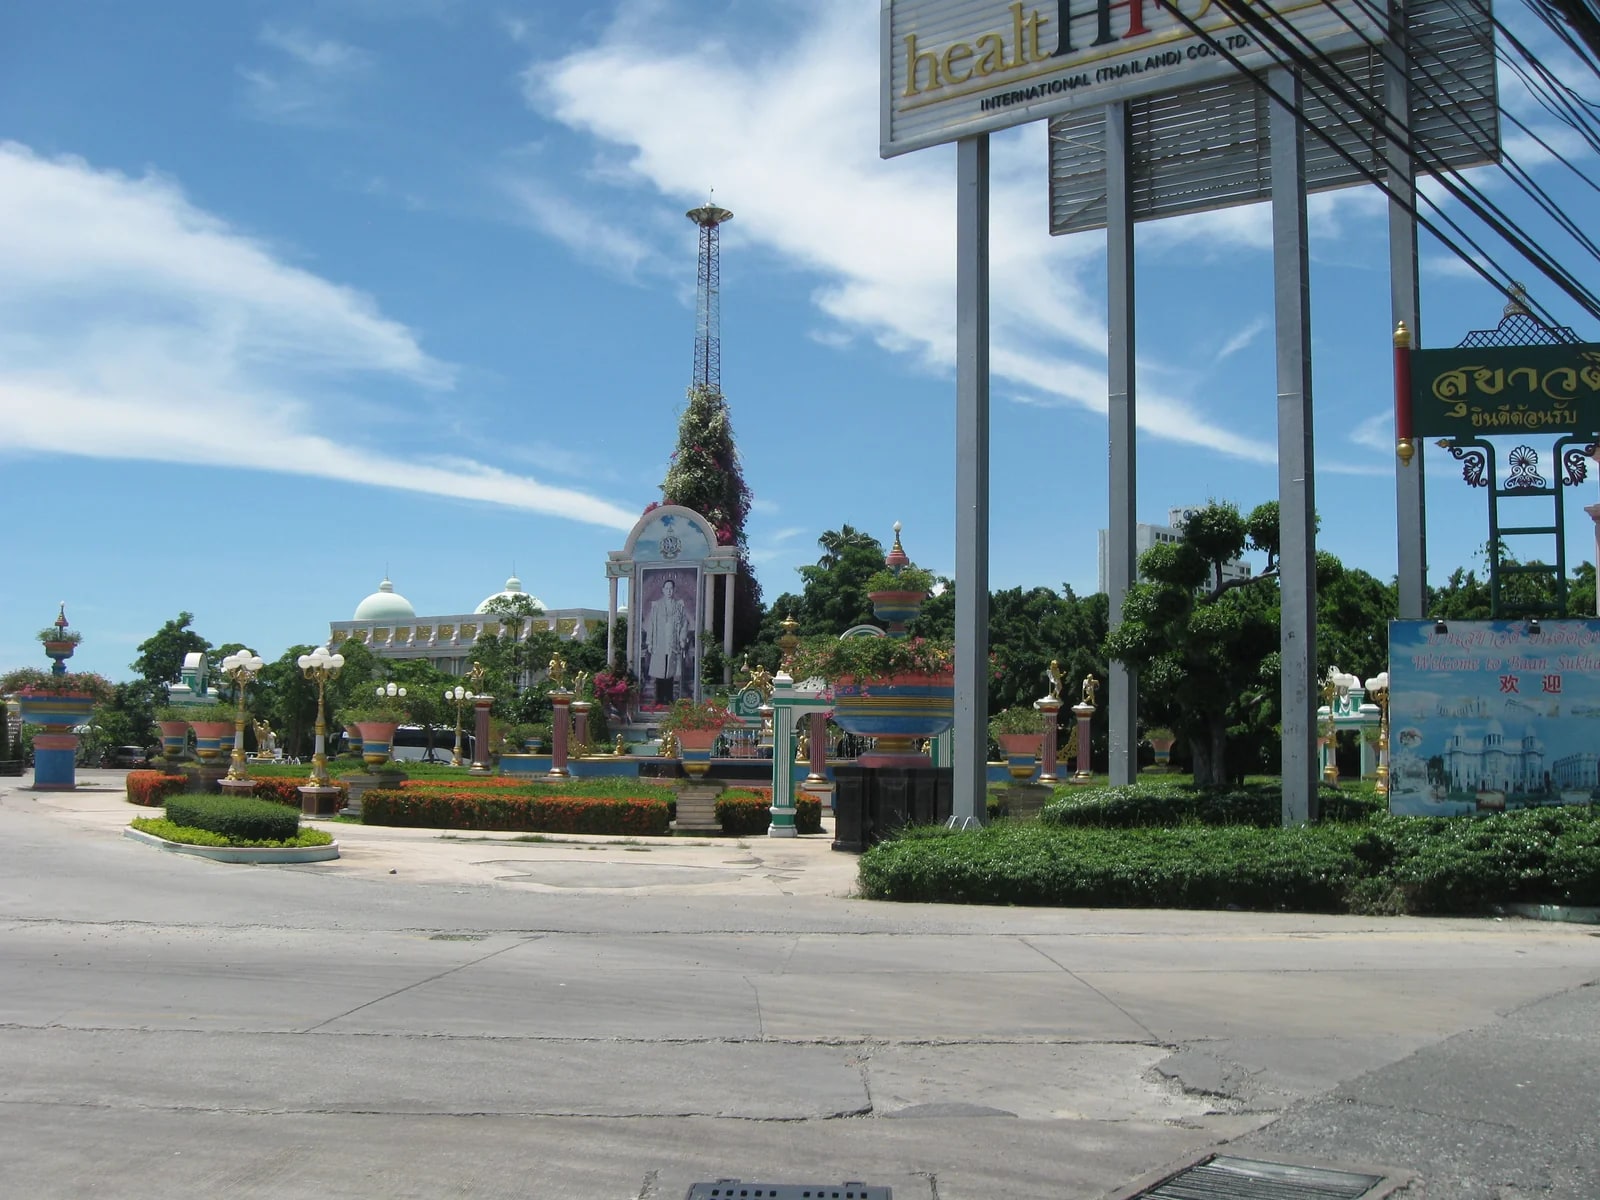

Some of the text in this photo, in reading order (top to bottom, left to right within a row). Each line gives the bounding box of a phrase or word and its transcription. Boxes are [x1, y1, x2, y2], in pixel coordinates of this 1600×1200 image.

[981, 73, 1090, 111] INTERNATIONAL
[1096, 49, 1181, 84] (THAILAND)
[1412, 652, 1600, 673] Welcome to Baan Sukha
